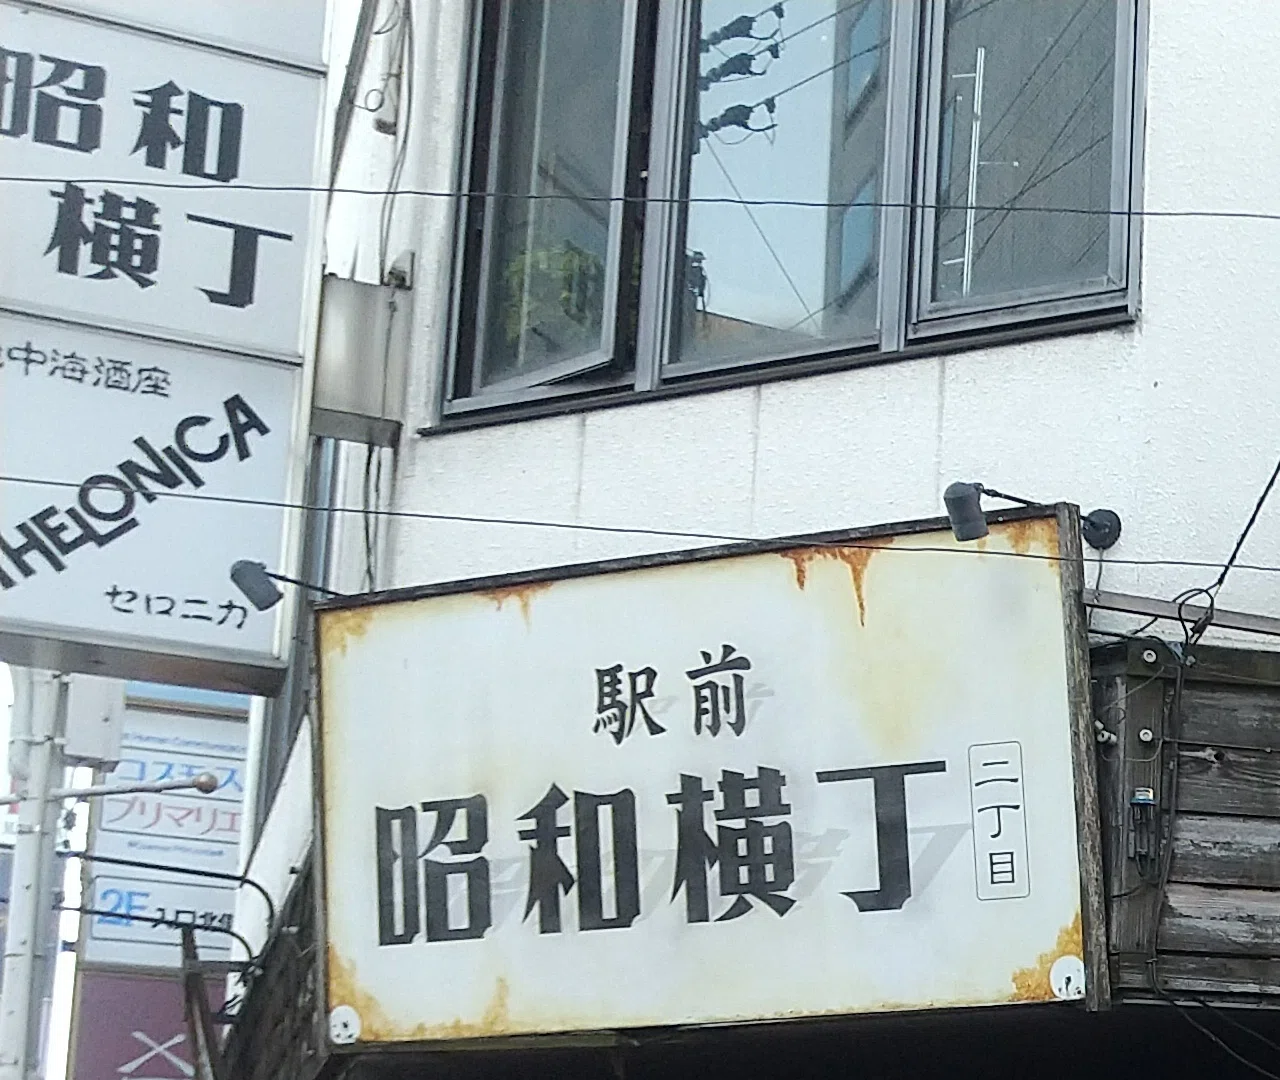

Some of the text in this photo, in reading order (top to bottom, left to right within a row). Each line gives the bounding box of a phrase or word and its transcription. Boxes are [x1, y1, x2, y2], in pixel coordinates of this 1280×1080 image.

[0, 46, 245, 183] 昭和
[43, 180, 294, 309] 横丁
[0, 340, 173, 399] 中海酒座
[104, 585, 249, 629] セロニカ
[592, 643, 753, 746] 駅前
[375, 760, 947, 947] 昭和横丁
[974, 759, 1020, 885] 二丁目
